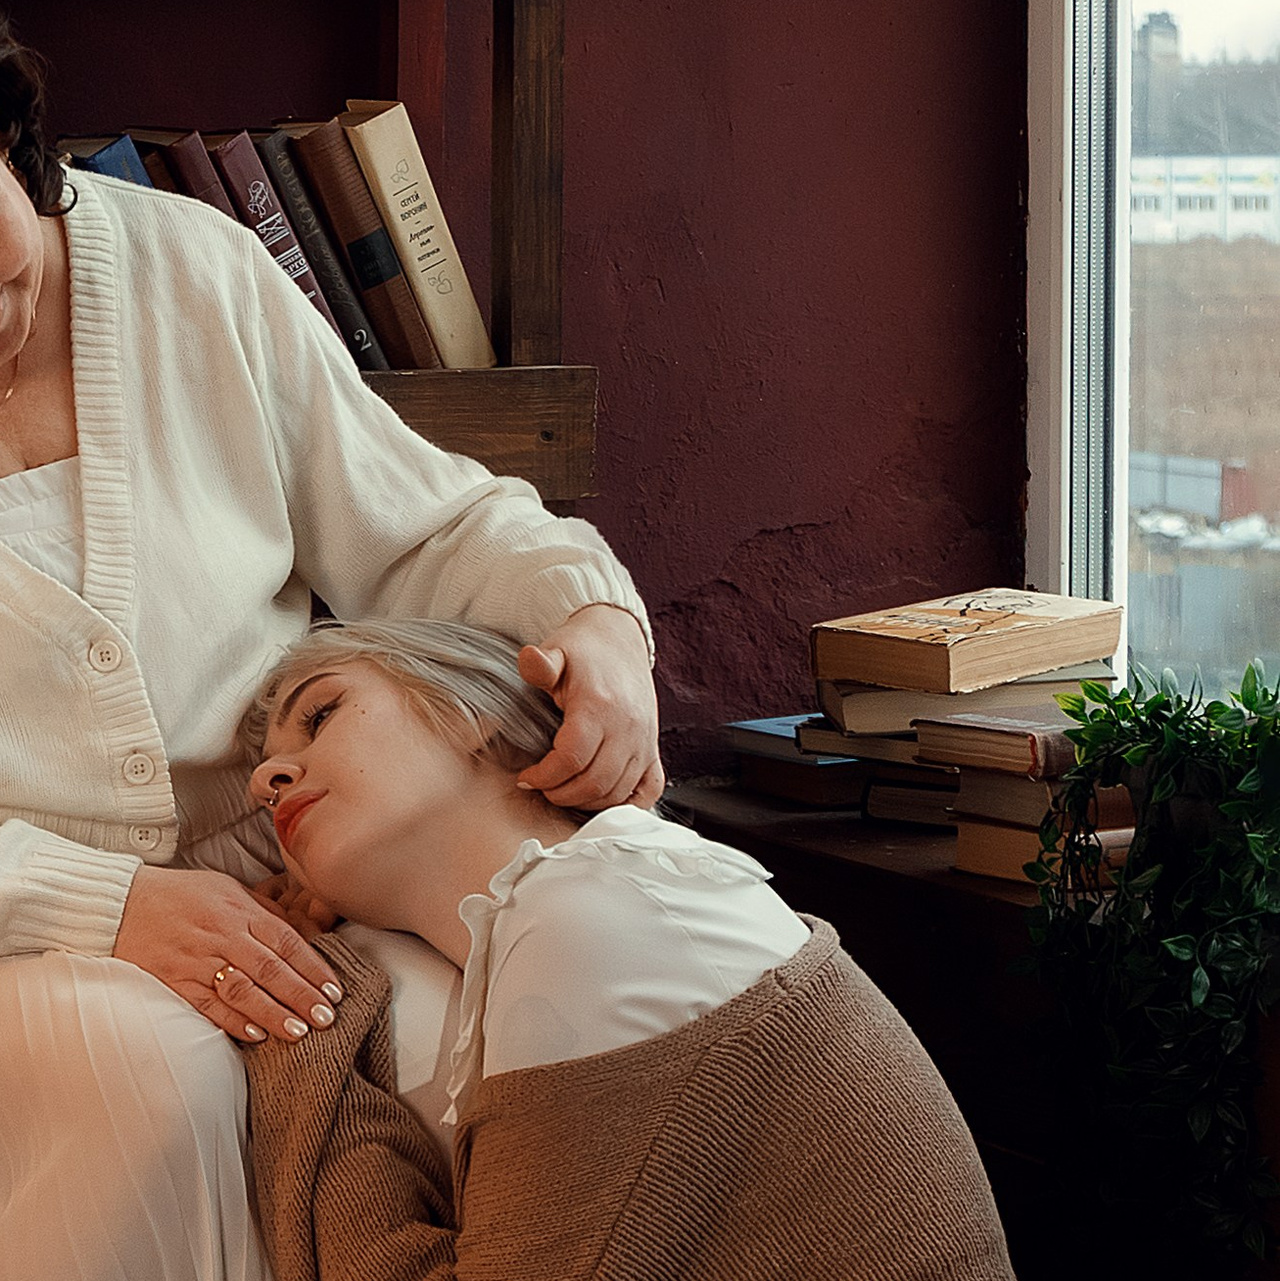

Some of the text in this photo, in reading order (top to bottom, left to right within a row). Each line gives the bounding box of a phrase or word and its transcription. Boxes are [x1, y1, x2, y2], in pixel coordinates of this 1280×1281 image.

[400, 191, 421, 208] СЕРГЕЙ
[400, 202, 429, 222] ВОРОНИН
[353, 328, 372, 352] 2
